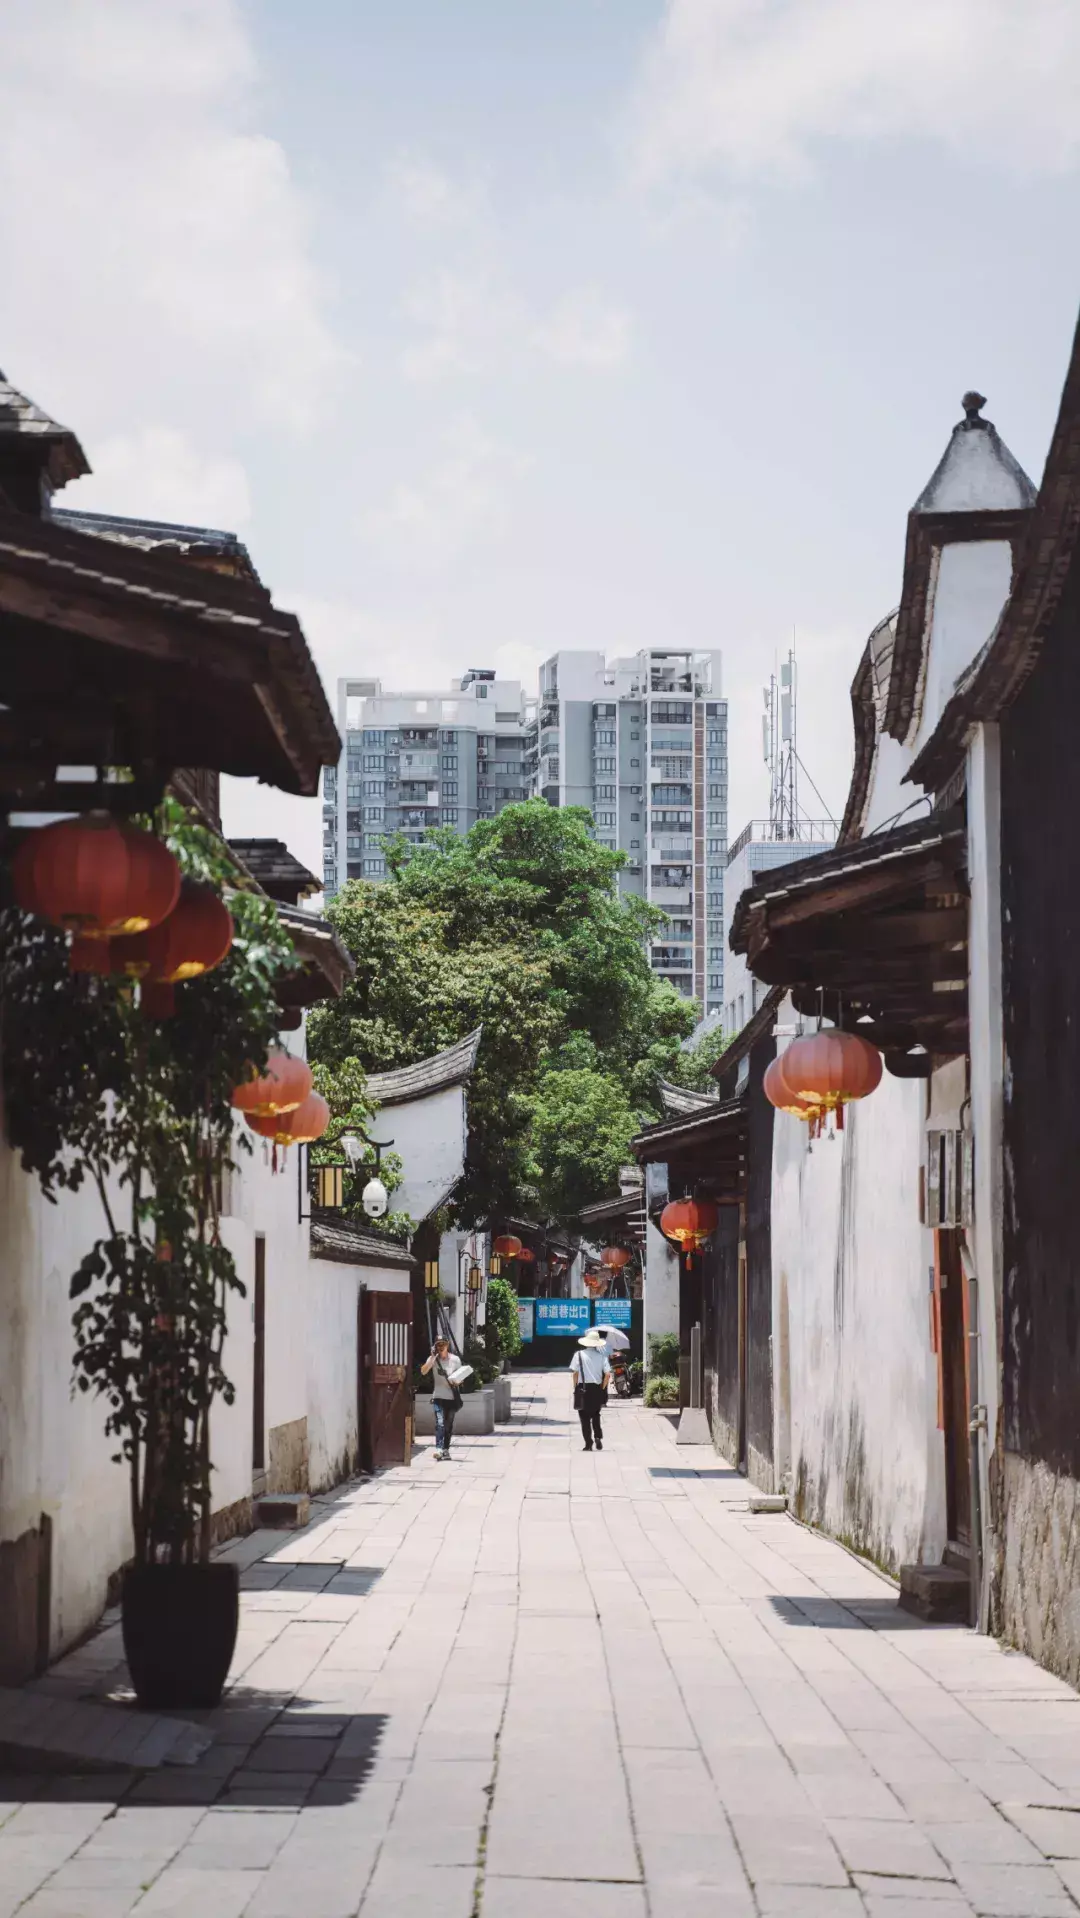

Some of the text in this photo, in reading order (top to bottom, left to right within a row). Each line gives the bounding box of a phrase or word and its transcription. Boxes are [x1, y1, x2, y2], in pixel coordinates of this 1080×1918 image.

[539, 1305, 588, 1319] 雅道巷出口
